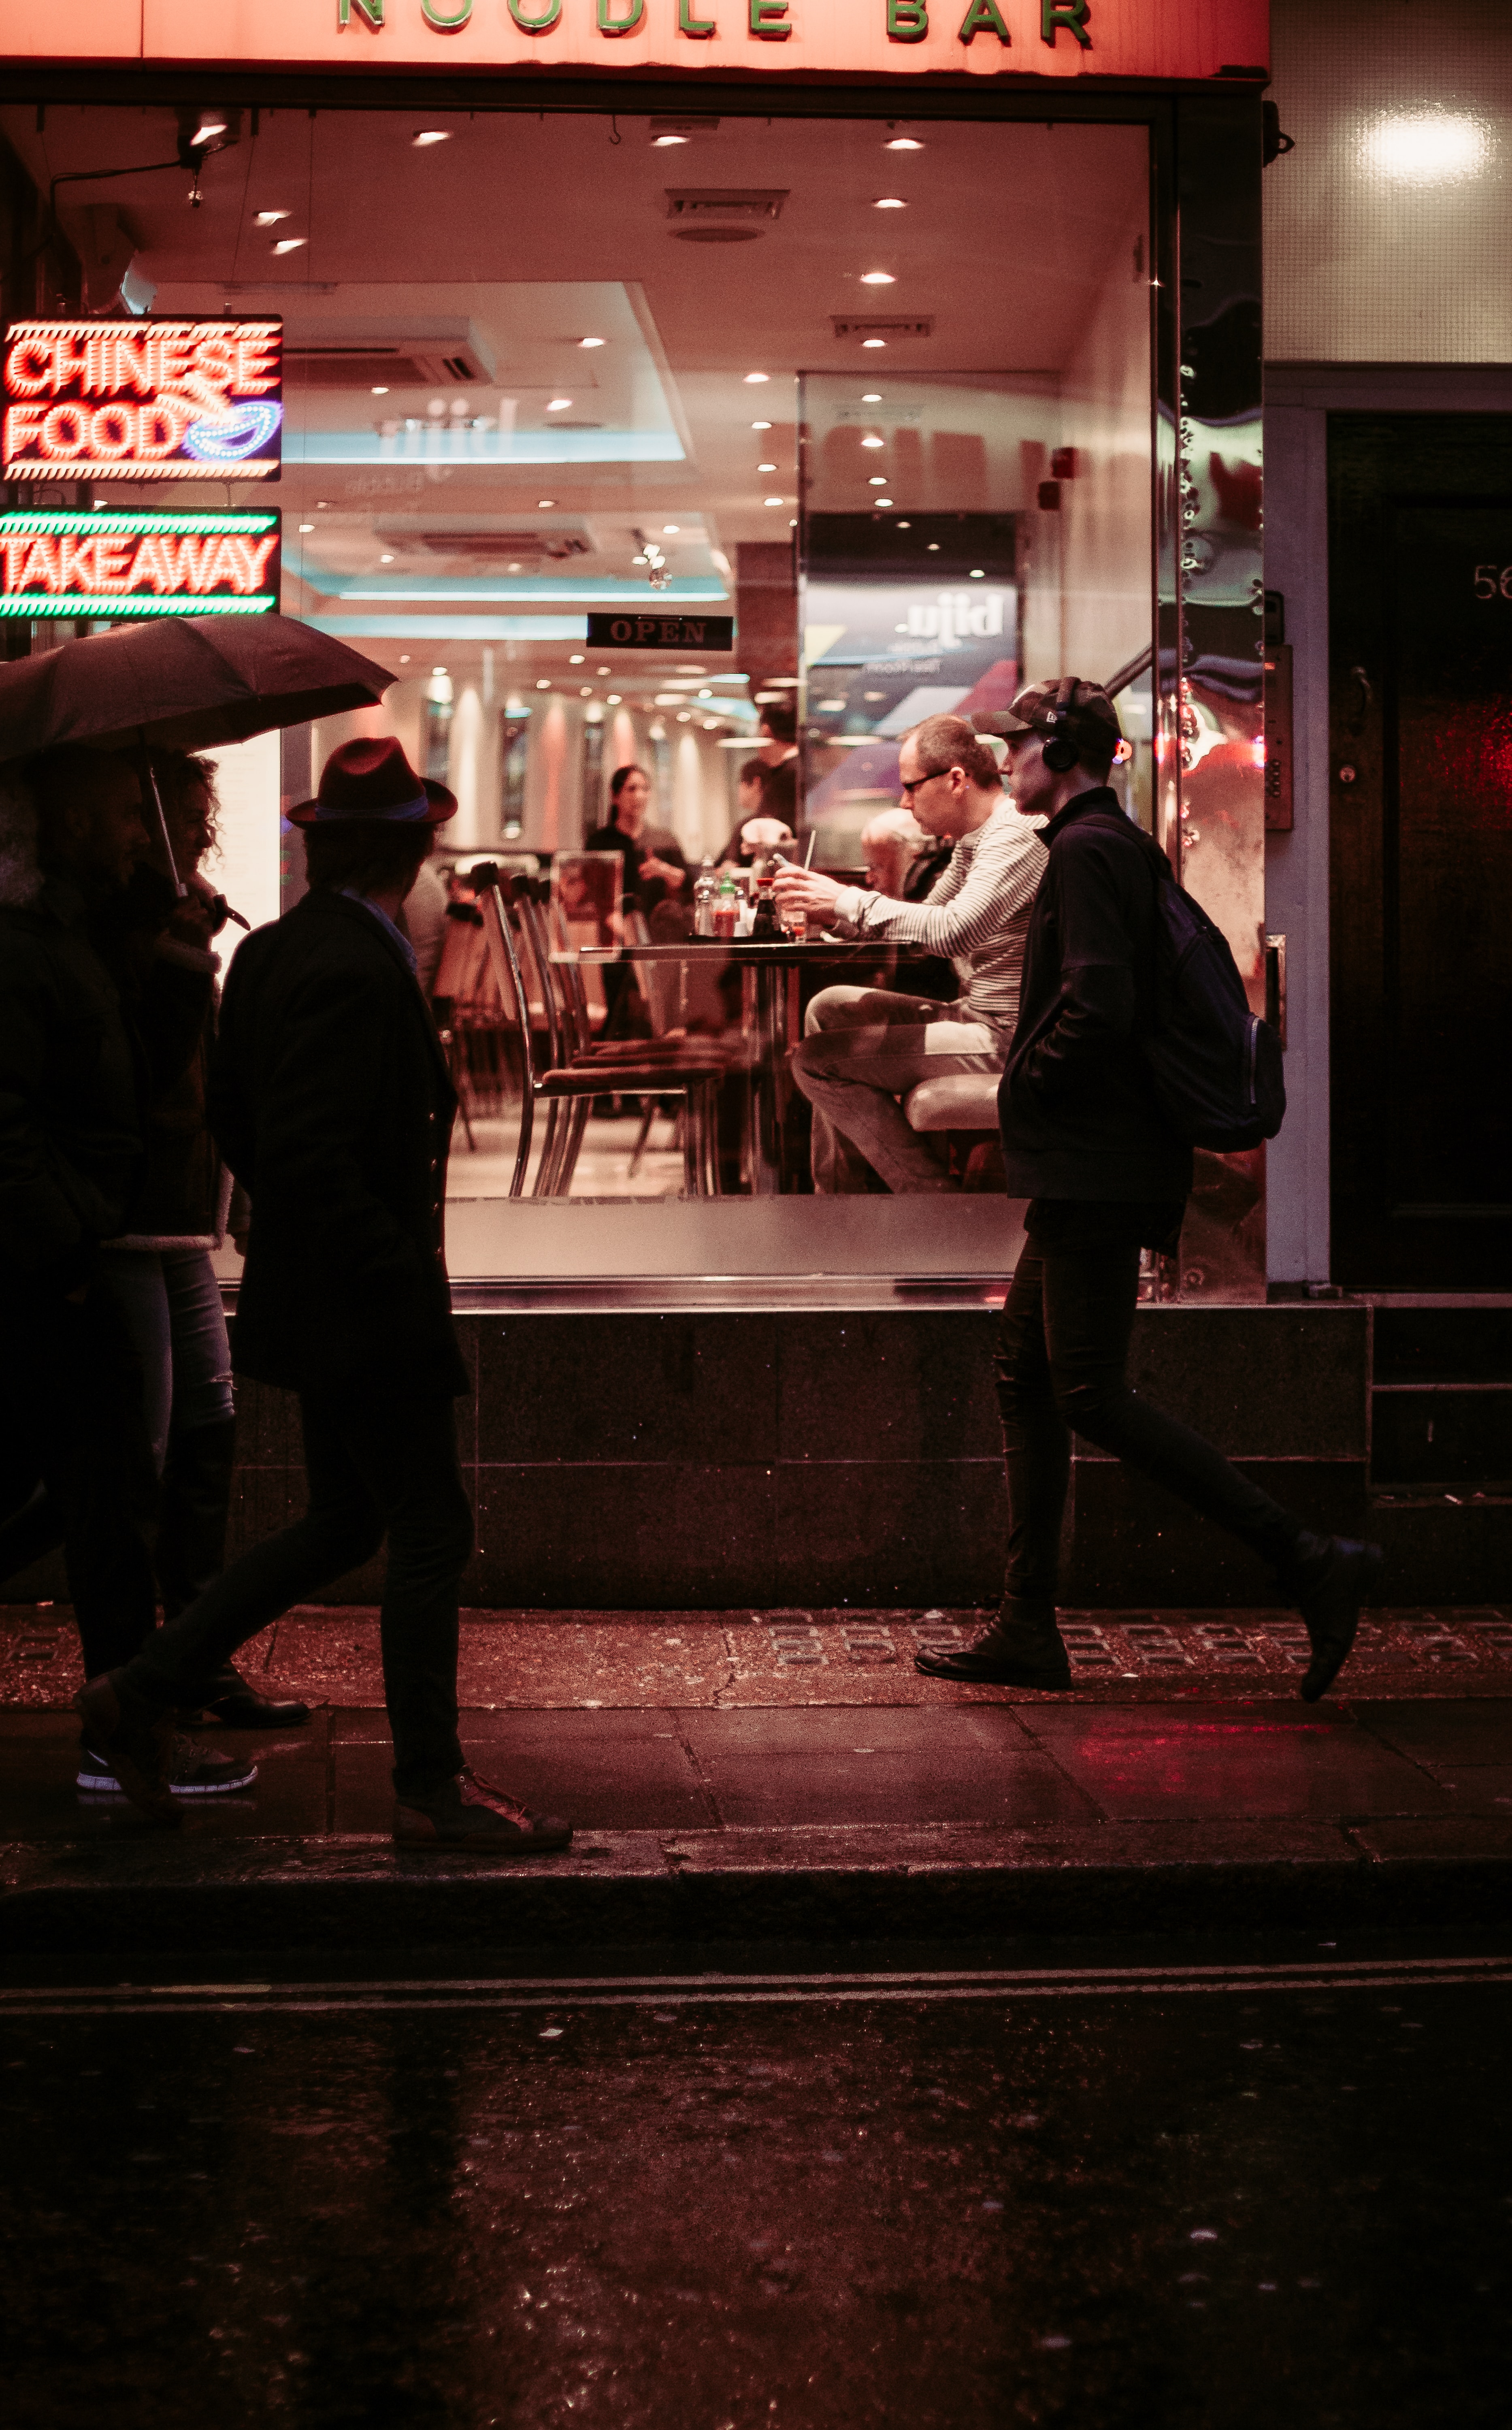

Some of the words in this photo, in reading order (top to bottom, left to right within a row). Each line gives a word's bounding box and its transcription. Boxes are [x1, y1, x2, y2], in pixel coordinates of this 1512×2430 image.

[887, 0, 1091, 43] BAR
[5, 337, 281, 396] CHINESE
[2, 401, 185, 463] FOOD
[0, 534, 279, 595] TAKEAWAY
[610, 620, 707, 643] OPEN
